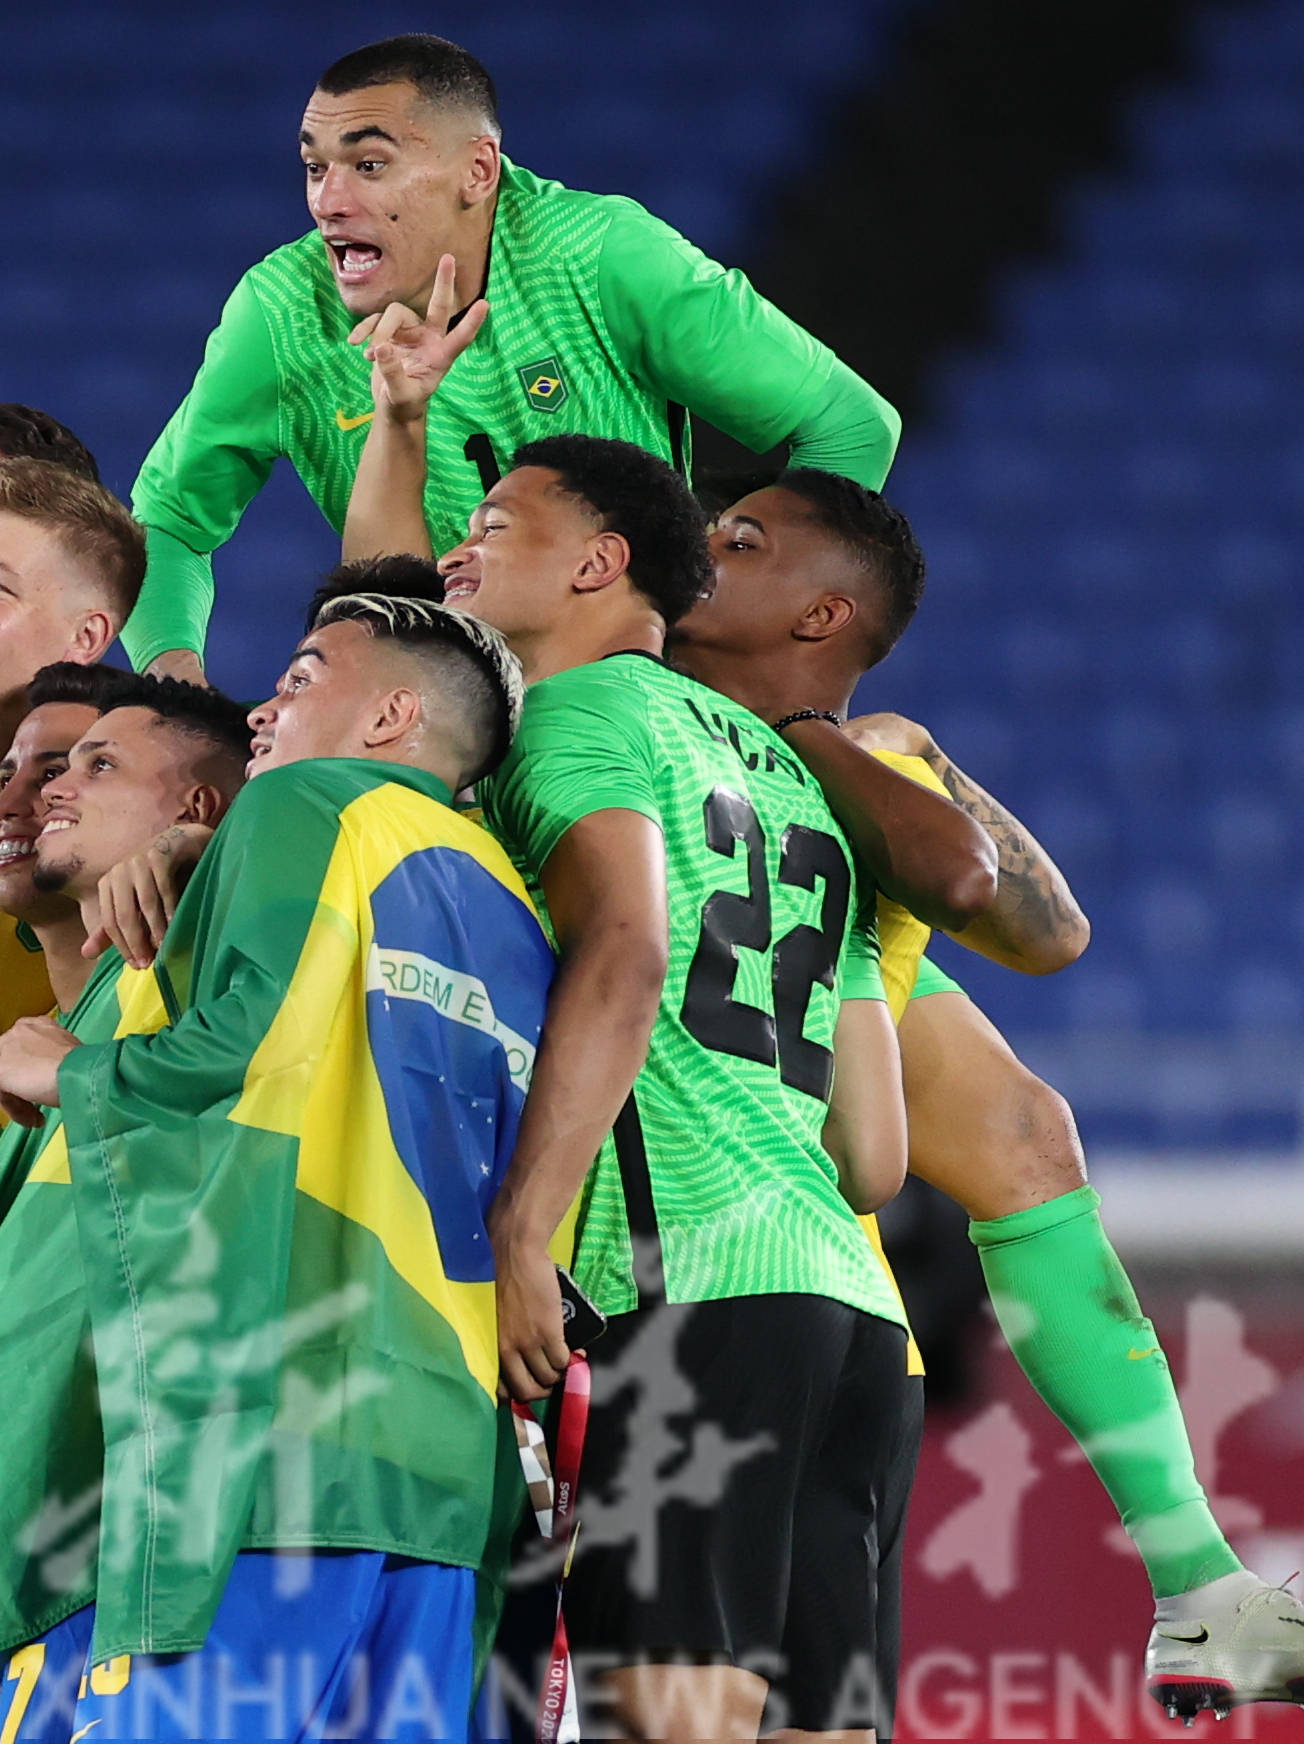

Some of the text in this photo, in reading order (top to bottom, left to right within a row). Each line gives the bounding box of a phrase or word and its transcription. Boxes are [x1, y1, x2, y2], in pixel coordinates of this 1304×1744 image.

[679, 785, 851, 1104] 22
[461, 991, 486, 1023] E
[0, 1643, 46, 1744] 7
[544, 1659, 564, 1708] TOKYO
